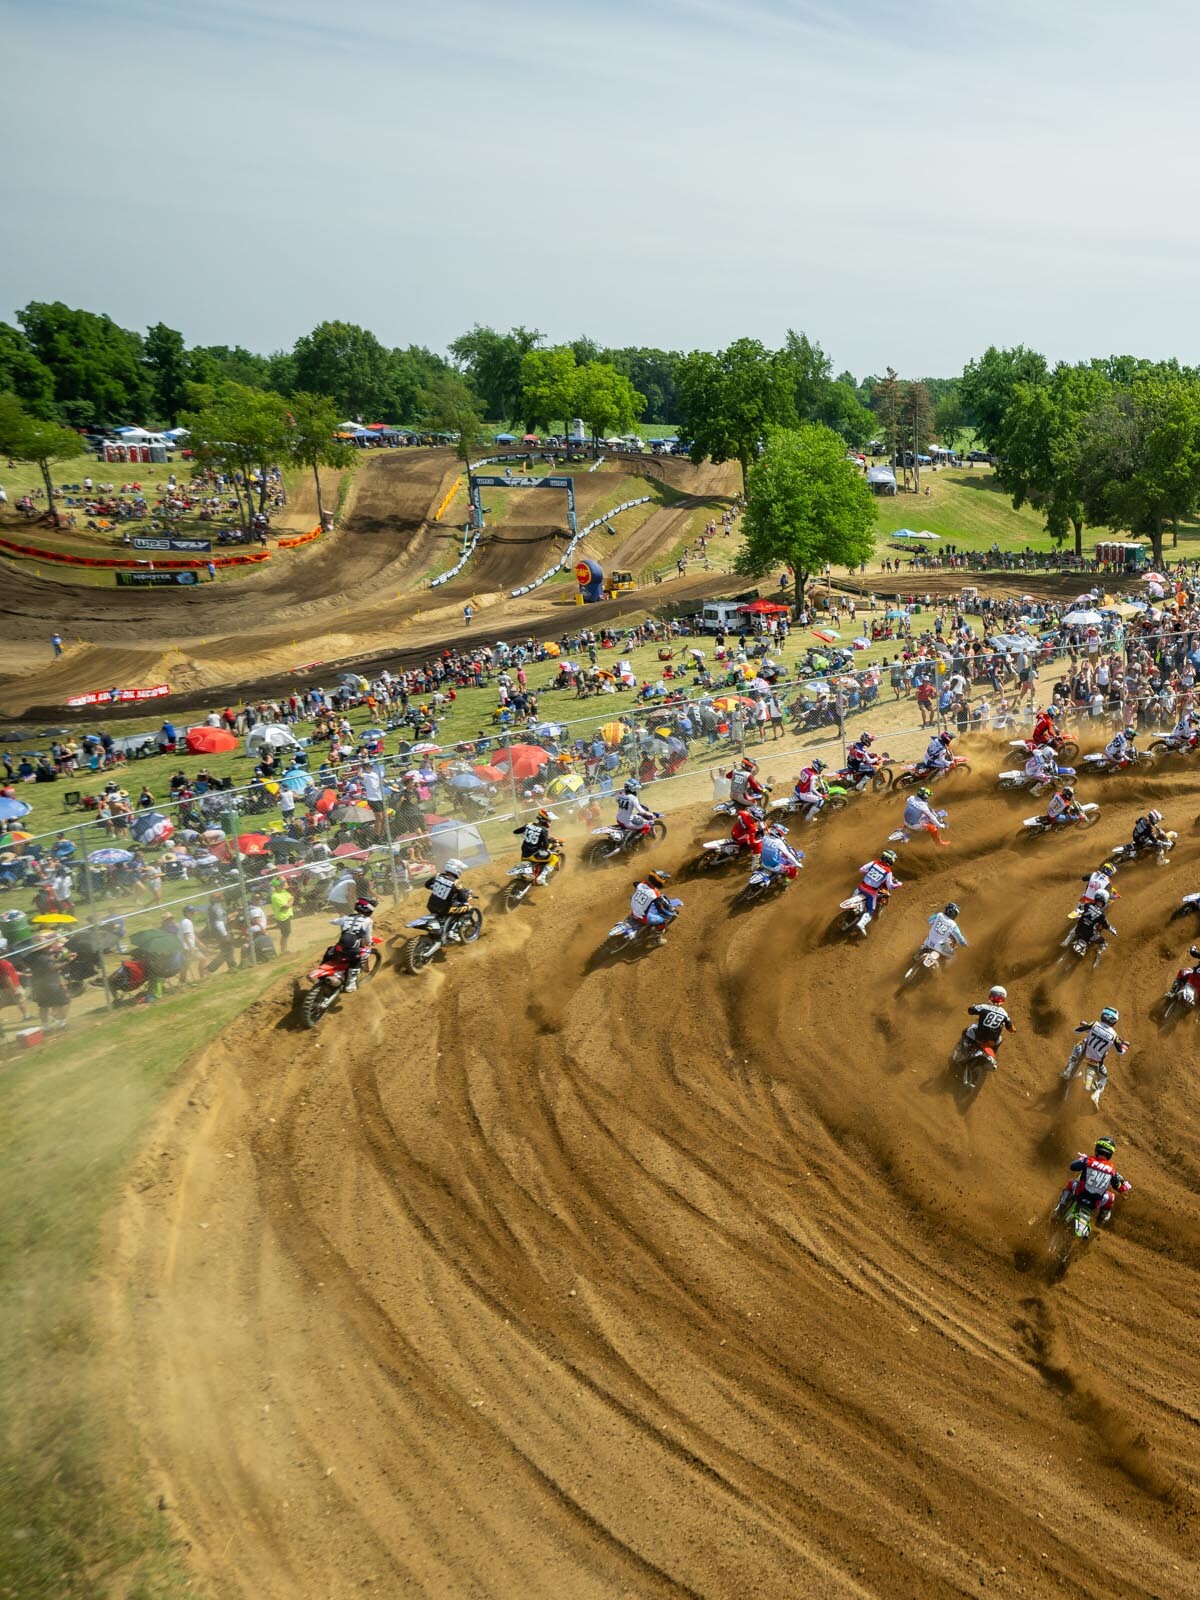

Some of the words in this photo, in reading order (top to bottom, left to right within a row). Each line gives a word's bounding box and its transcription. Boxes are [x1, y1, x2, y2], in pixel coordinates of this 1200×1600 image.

[985, 1012, 1005, 1028] 85
[1088, 1032, 1110, 1053] 777
[1091, 1160, 1113, 1173] PAPI
